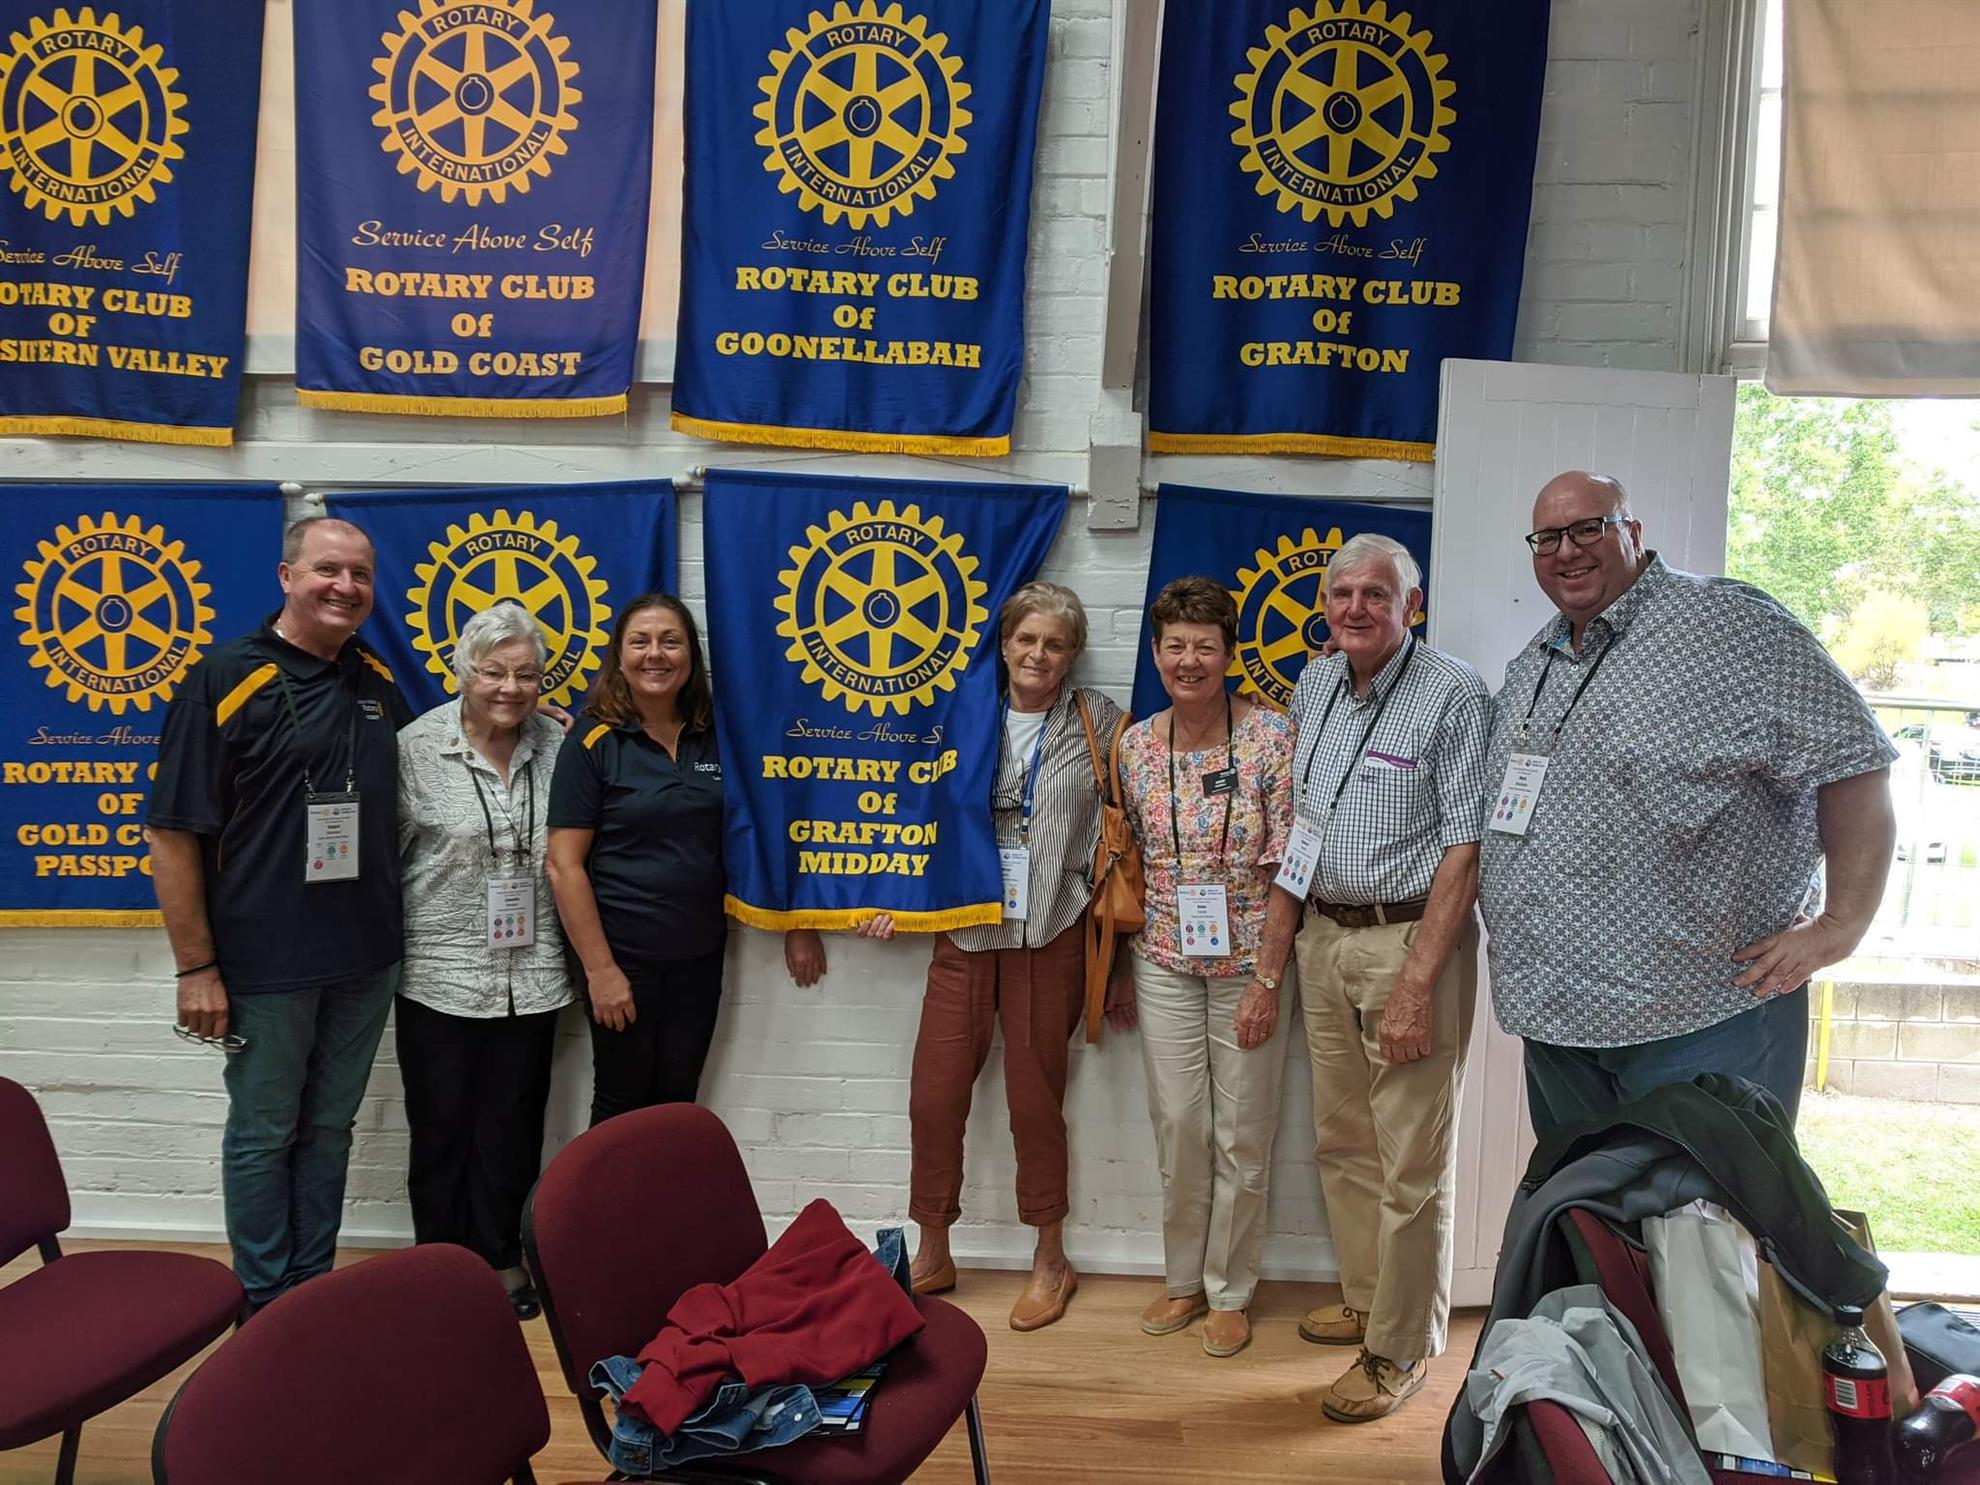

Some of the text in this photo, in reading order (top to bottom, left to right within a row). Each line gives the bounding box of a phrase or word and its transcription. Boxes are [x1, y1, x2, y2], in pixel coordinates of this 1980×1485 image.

[432, 6, 519, 33] ROTARY
[41, 32, 130, 59] ROTARY
[825, 25, 907, 48] ROTARY
[1307, 21, 1391, 46] ROTARY
[402, 126, 549, 182] INTERNATIONAL
[13, 147, 155, 202] INTERNATIONAL
[785, 145, 934, 206] INTERNATIONAL
[1262, 146, 1416, 203] INTERNATIONAL
[351, 220, 595, 258] Service Above Self
[761, 229, 947, 266] Service Above Self
[1238, 232, 1429, 268] Service Above Self
[52, 244, 124, 271] Above
[131, 251, 183, 286] Self
[344, 266, 596, 300] ROTARY CLUB
[735, 266, 979, 301] ROTARY CLUB
[1212, 273, 1462, 307] ROTARY CLUB
[102, 288, 193, 319] CLUB
[48, 312, 97, 338] OF
[451, 312, 495, 338] Of
[832, 304, 876, 331] Of
[1312, 308, 1353, 335] Of
[106, 346, 229, 379] VALLEY
[359, 346, 582, 377] GOLD COAST
[715, 331, 982, 368] GOONELLABAH
[1239, 341, 1410, 373] GRAFTON
[69, 534, 153, 559] ROTARY
[465, 533, 542, 557] ROTARY
[845, 524, 925, 548] ROTARY
[48, 644, 188, 693] INTERNATIONAL
[807, 638, 952, 694] INTERNATIONAL
[27, 725, 162, 746] Service Above
[785, 718, 853, 740] Service
[857, 722, 918, 744] Above
[3, 762, 139, 784] ROTARY
[762, 755, 901, 783] ROTARY
[97, 793, 144, 815] OF
[857, 791, 898, 815] Of
[17, 824, 109, 846] GOLD
[788, 820, 938, 846] GRAFTON
[798, 850, 930, 876] MIDDAY
